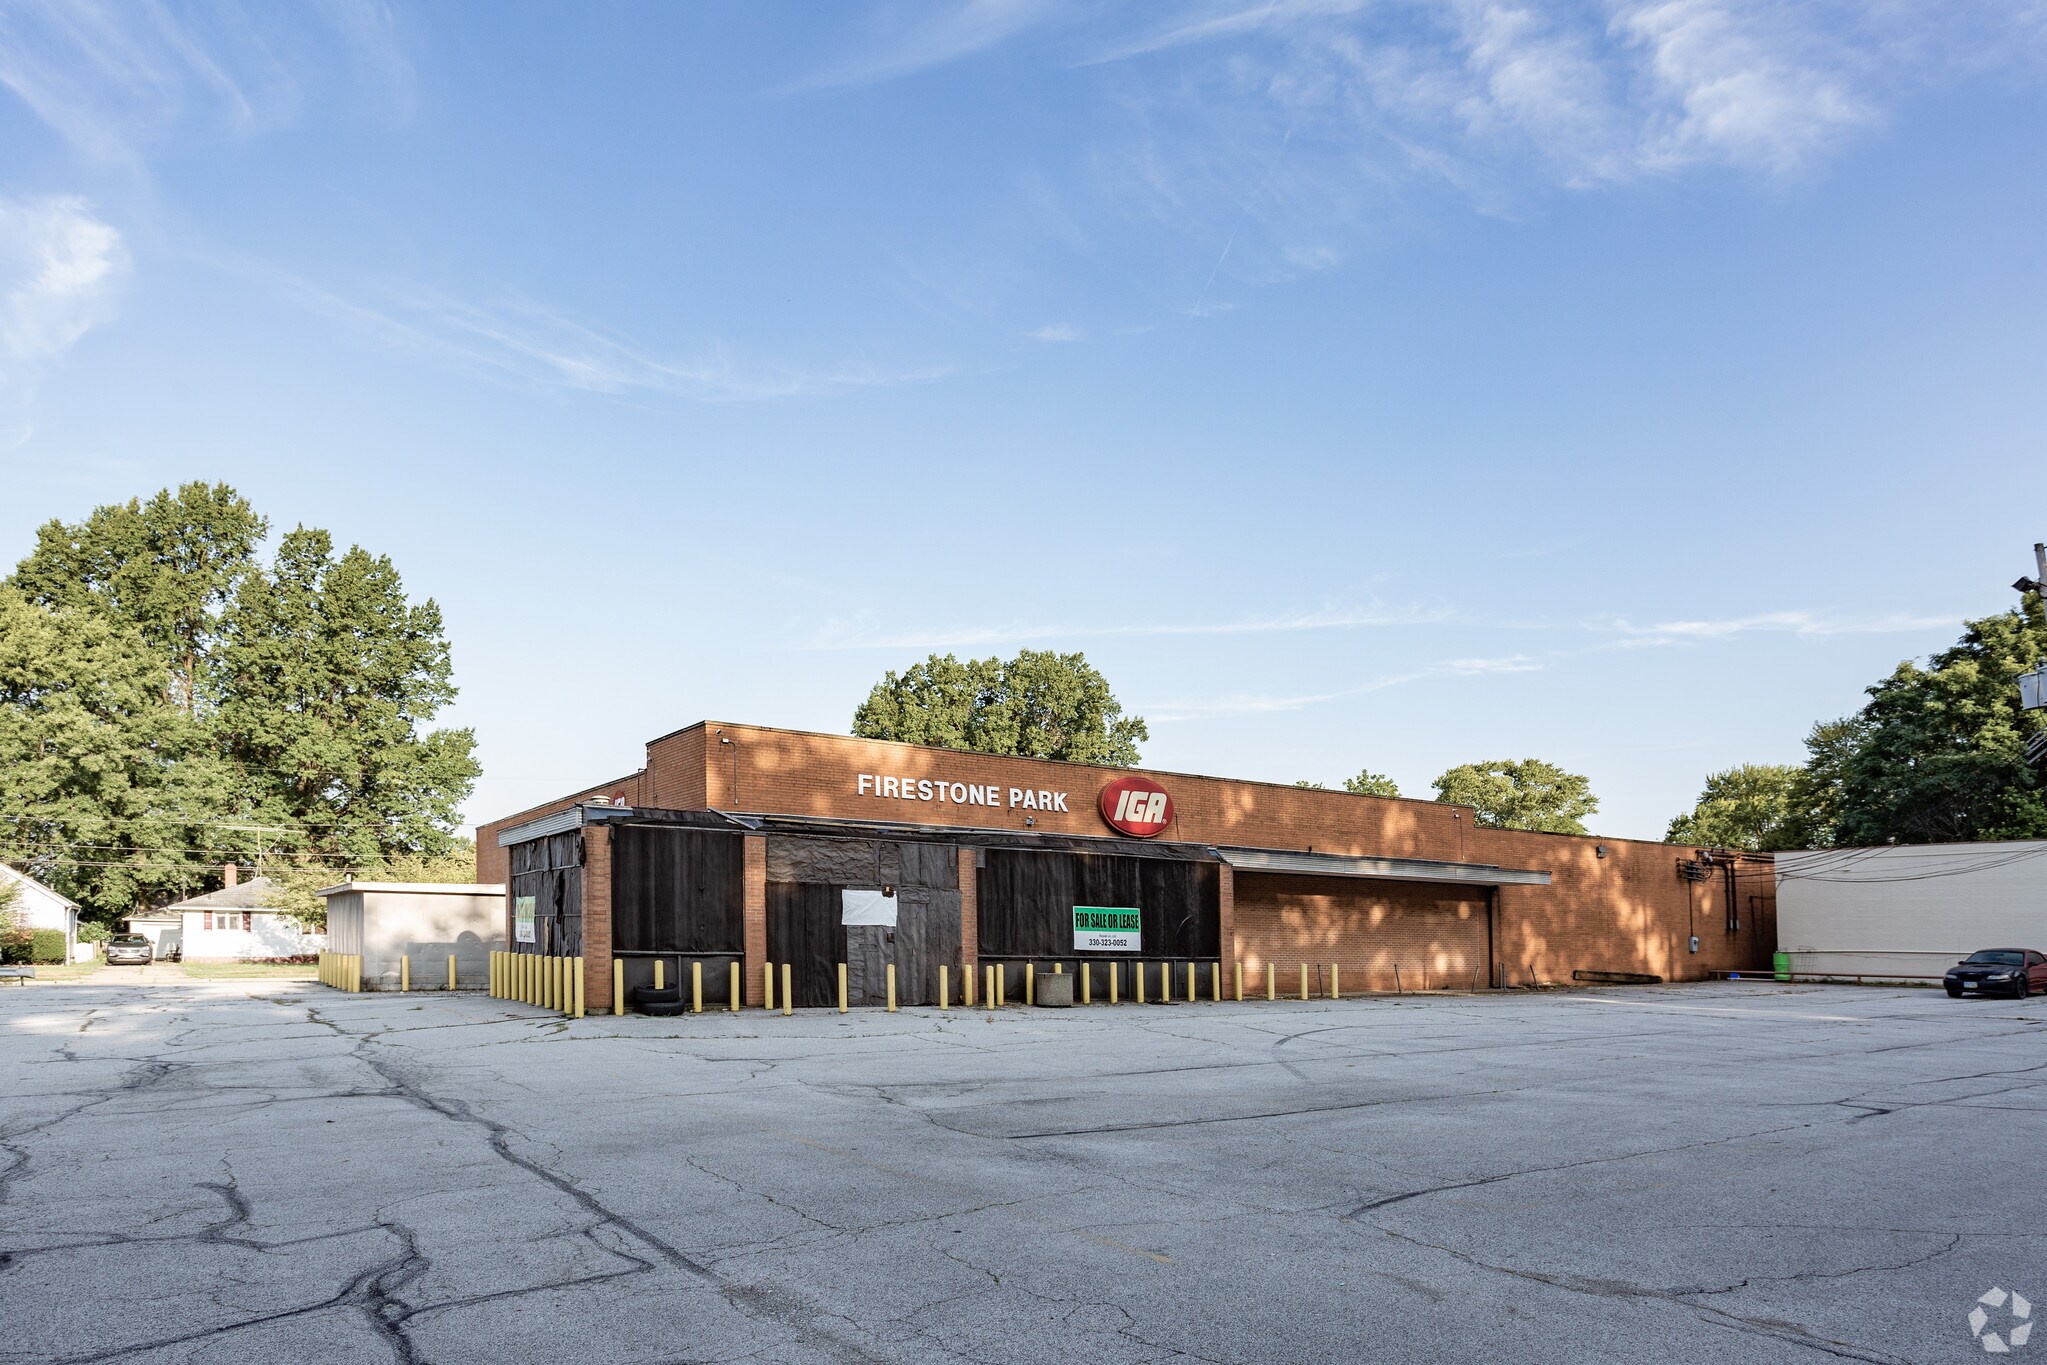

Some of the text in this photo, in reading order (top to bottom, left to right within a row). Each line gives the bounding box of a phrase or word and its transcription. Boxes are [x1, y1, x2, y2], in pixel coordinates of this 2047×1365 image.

[858, 773, 1068, 813] FIRESTONE PARK
[1114, 790, 1167, 824] IGA
[1076, 913, 1139, 929] FOR SALE OR LEASE
[1088, 938, 1127, 946] 330-323-0052
